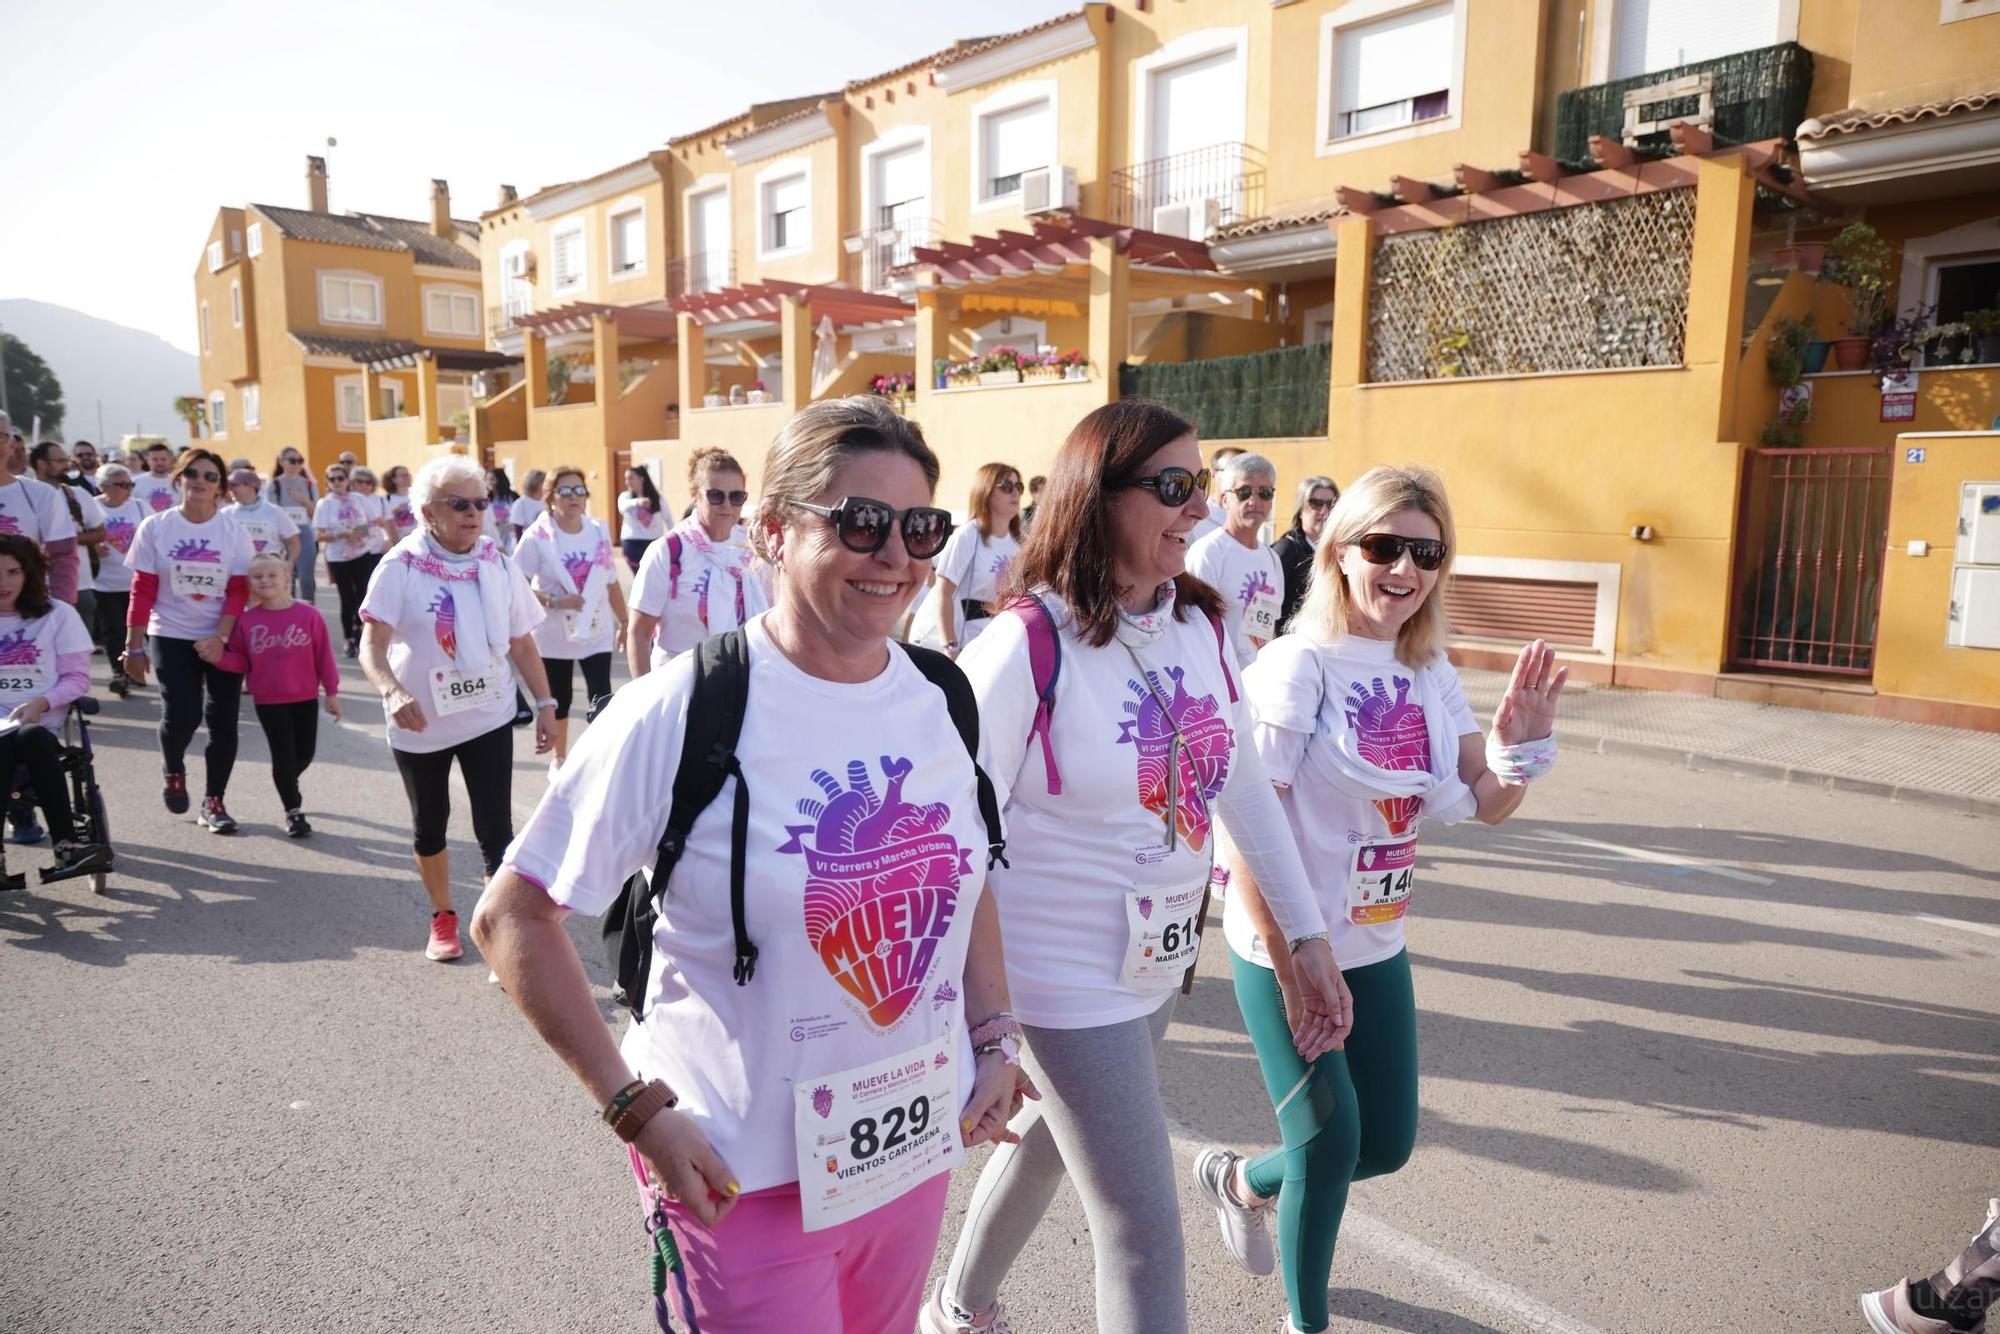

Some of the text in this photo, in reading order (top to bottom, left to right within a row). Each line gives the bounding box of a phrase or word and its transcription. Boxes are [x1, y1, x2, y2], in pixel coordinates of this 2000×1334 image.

[1906, 448, 1925, 463] 21
[184, 575, 215, 586] 772
[249, 623, 312, 654] Barbie
[0, 678, 34, 690] 623
[450, 677, 486, 697] 864
[816, 841, 952, 874] VI Carrera y Marcha Urbana
[1165, 893, 1189, 905] MUEVE
[1375, 897, 1389, 905] ANA
[820, 887, 958, 977] MUEVE
[1162, 914, 1199, 953] 61
[876, 942, 891, 956] la
[1155, 952, 1180, 963] MARIA
[834, 937, 939, 1009] VIDA
[851, 1072, 889, 1093] MUEVE
[890, 1067, 903, 1080] LA
[904, 1059, 926, 1076] VIDA
[850, 1095, 930, 1160] 829
[836, 1155, 886, 1180] VIENTOS
[888, 1126, 940, 1161] CARTAGENA
